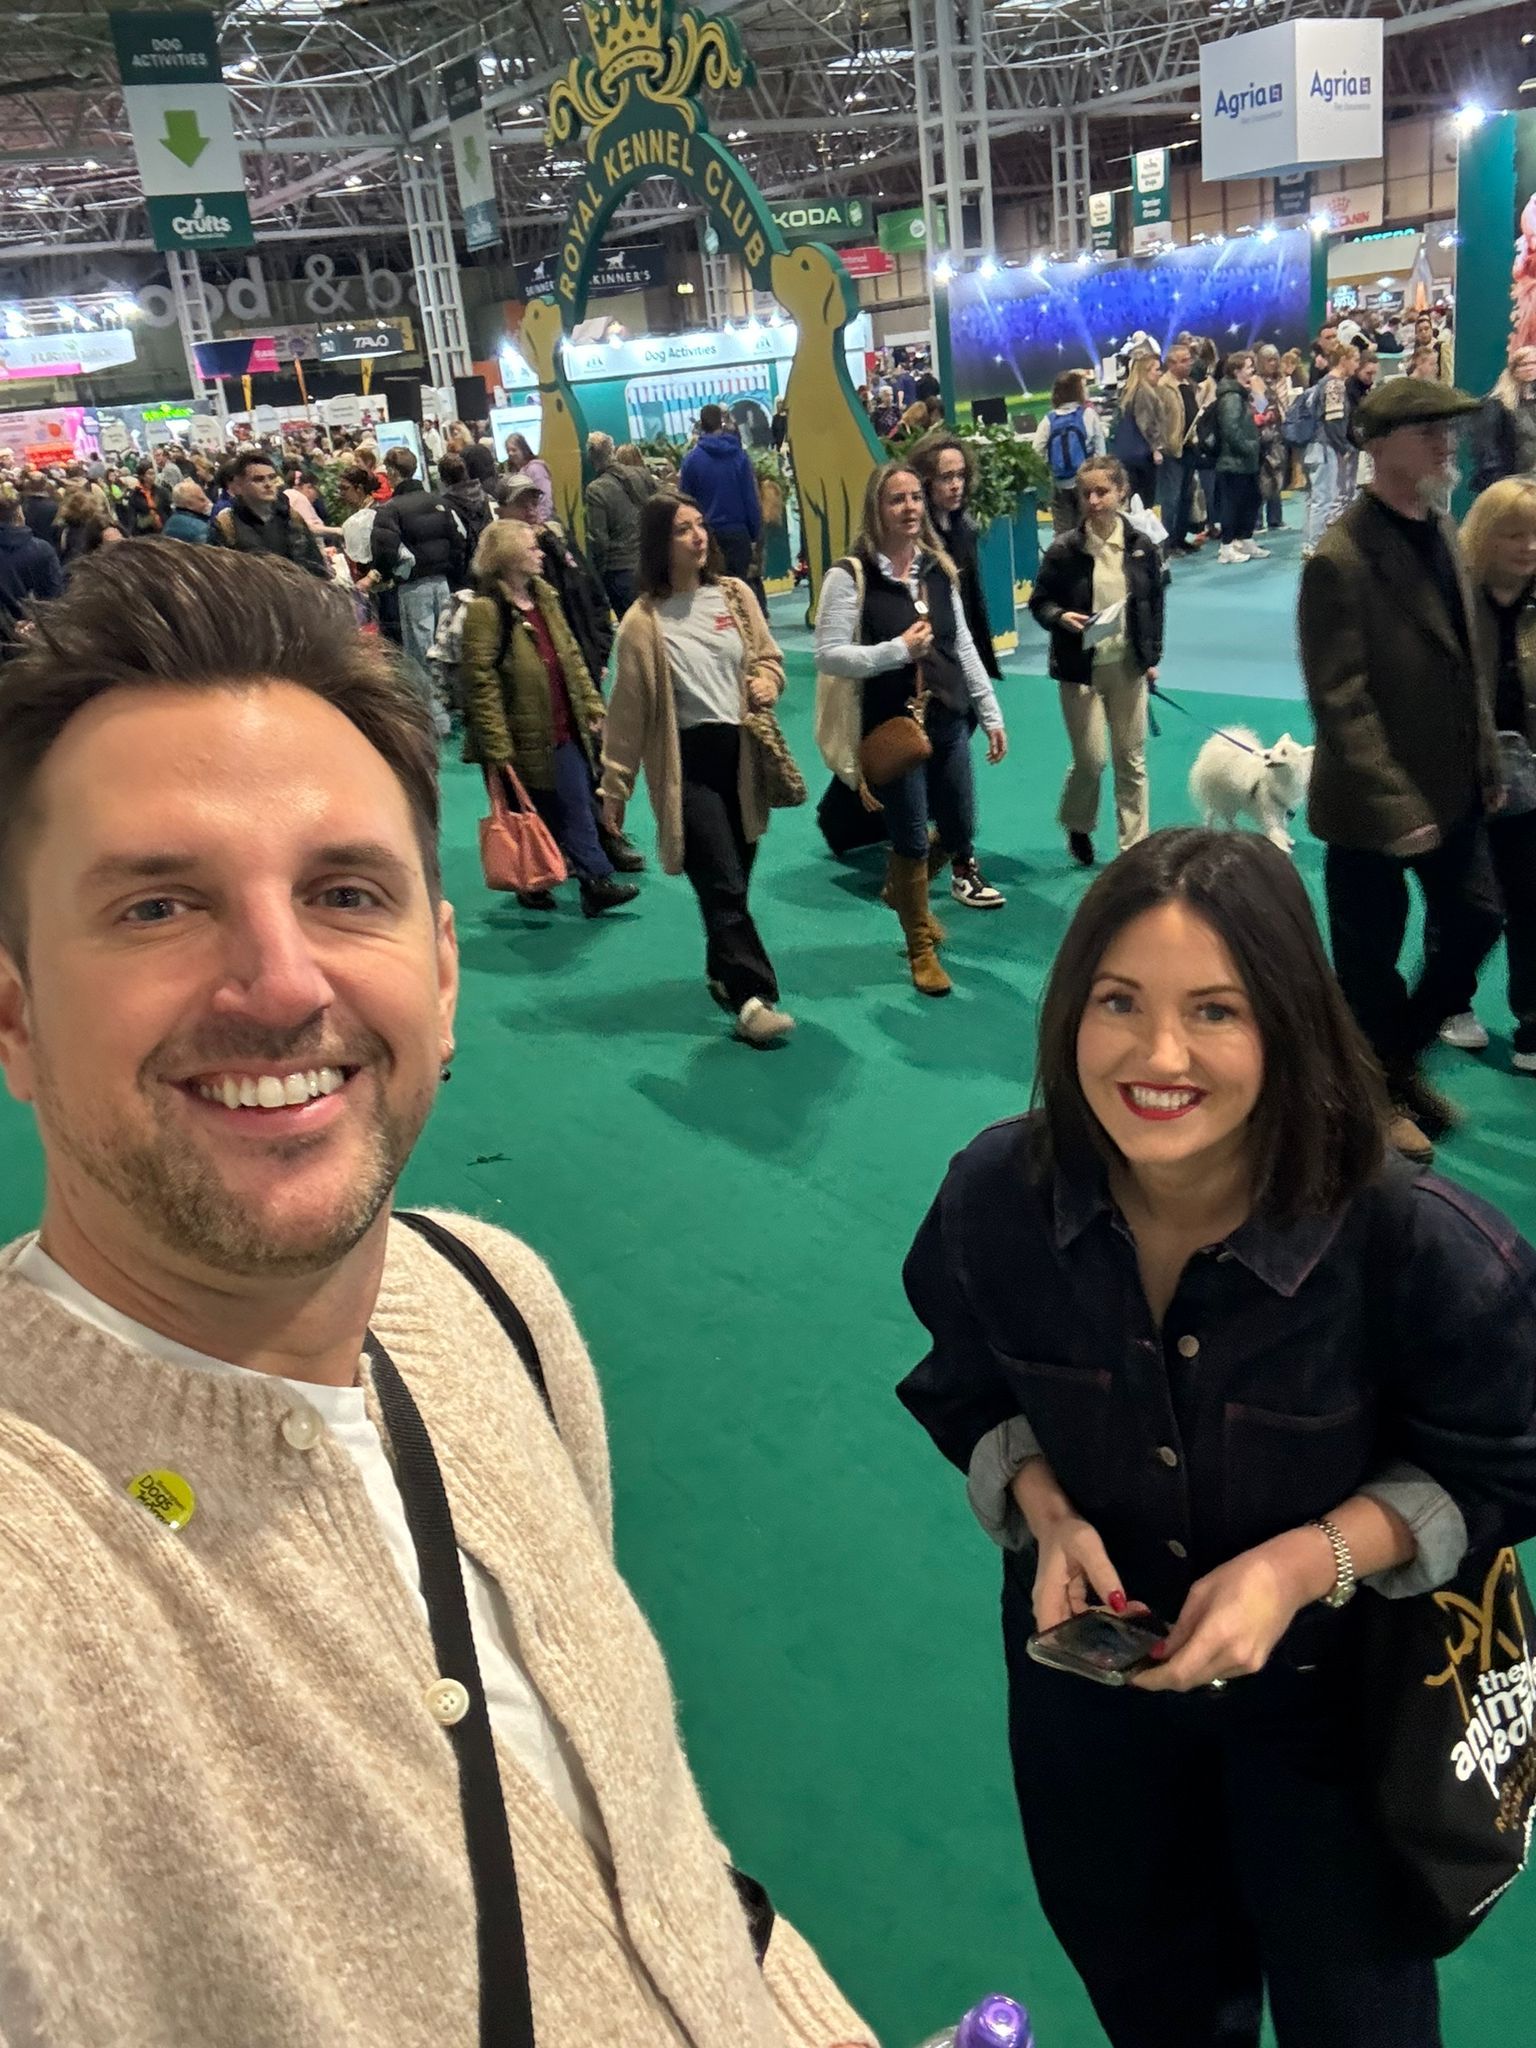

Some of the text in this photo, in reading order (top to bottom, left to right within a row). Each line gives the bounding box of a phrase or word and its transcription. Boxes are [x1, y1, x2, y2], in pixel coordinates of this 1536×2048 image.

[151, 37, 183, 52] DOG
[131, 53, 208, 68] ACTIVITIES
[1309, 69, 1357, 103] Agria
[1214, 82, 1266, 119] Agria
[171, 214, 233, 235] Crufts
[559, 129, 765, 301] ROYAL KENNEL CLUB
[771, 207, 842, 228] KODA
[588, 270, 652, 286] KINNER'S
[645, 345, 717, 363] Dog Activities
